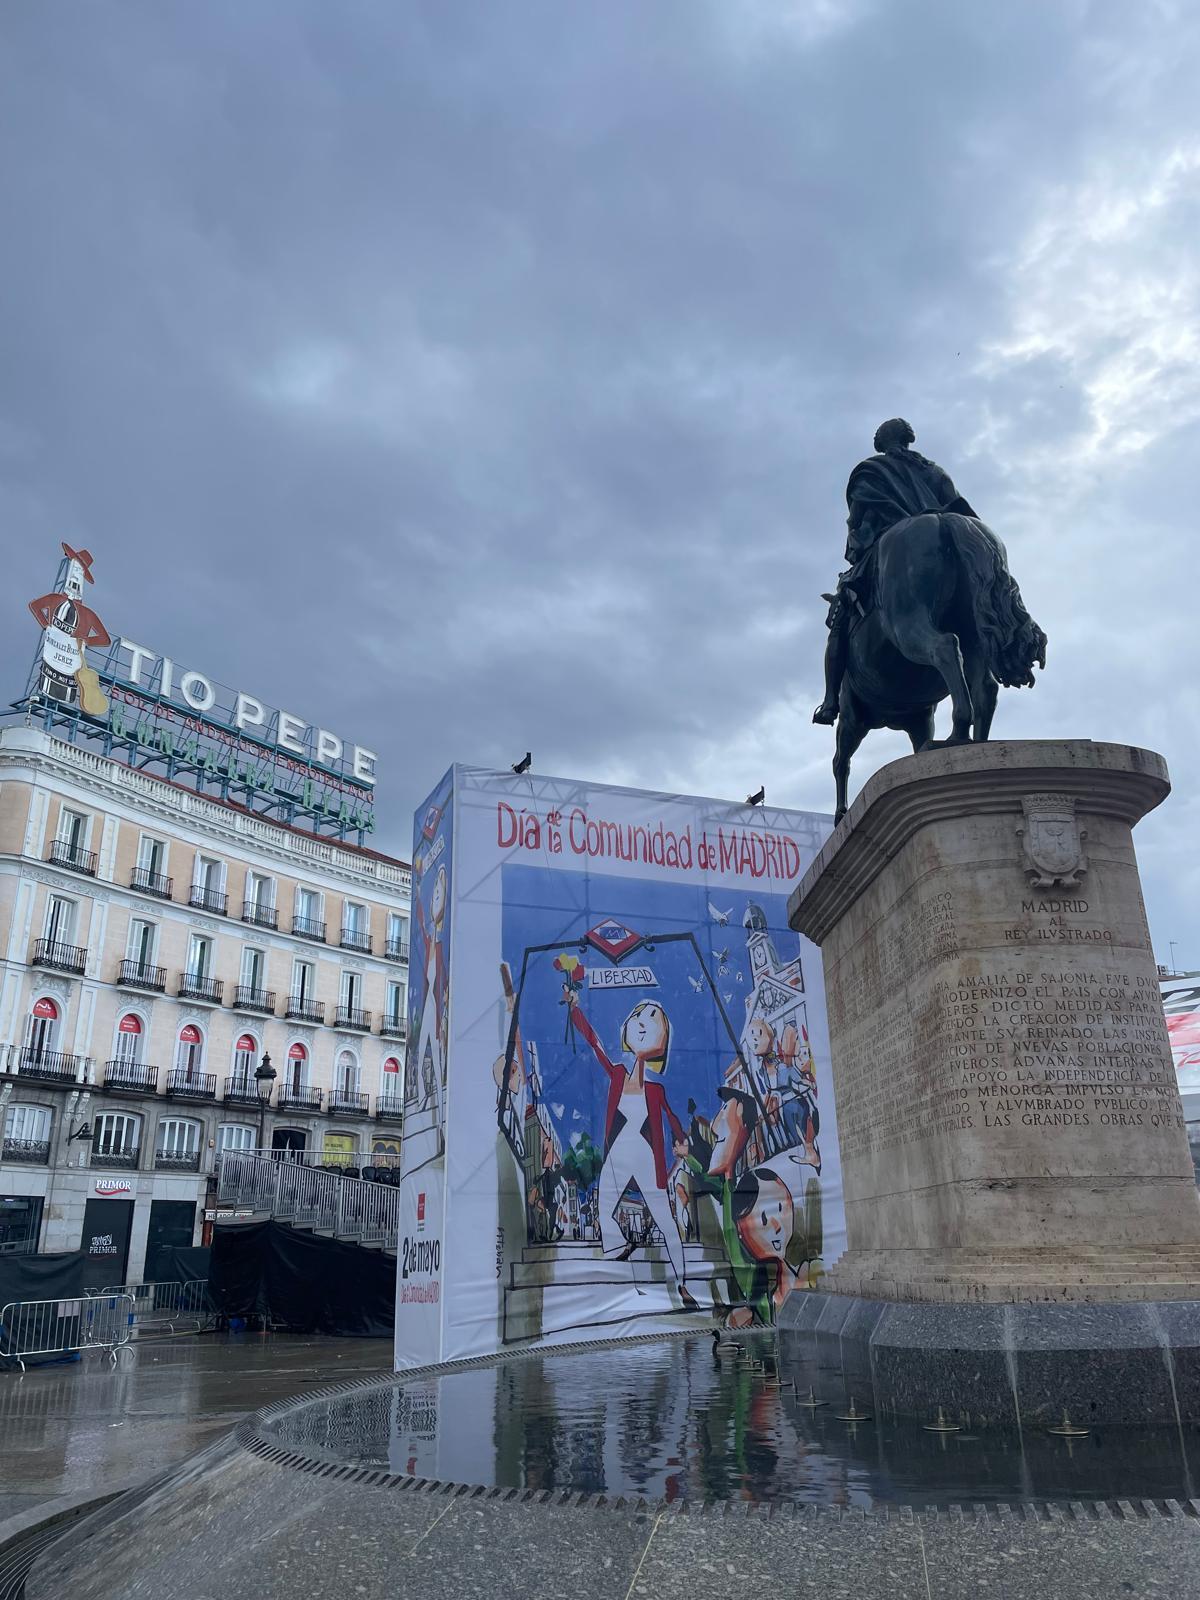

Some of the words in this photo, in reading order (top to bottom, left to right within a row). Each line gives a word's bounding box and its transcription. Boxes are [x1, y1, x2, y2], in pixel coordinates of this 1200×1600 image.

[111, 686, 147, 712] SOL
[154, 703, 176, 721] DE
[120, 637, 216, 711] TIO
[236, 691, 377, 785] PEPE
[547, 804, 562, 827] de
[498, 802, 540, 849] Día
[549, 826, 563, 853] la
[569, 808, 693, 869] Comunidad
[698, 832, 717, 871] de
[719, 827, 800, 879] MADRID
[1021, 900, 1089, 913] MADRID
[1049, 916, 1066, 926] AL
[1005, 929, 1032, 940] REY
[1038, 929, 1112, 940] ILVSTRADO
[592, 969, 652, 985] LIBERTAD
[958, 975, 1009, 988] AMALIA
[1016, 973, 1033, 984] DE
[1106, 974, 1129, 985] FVE
[943, 986, 1027, 1004] MODERNIZO
[1035, 986, 1052, 997] EL
[1062, 986, 1090, 997] PAIS
[1100, 987, 1126, 998] CON
[992, 1001, 1044, 1012] DICTO
[1055, 1001, 1121, 1012] MEDIDAS
[1129, 1002, 1156, 1016] PARA
[983, 1015, 1000, 1026] LA
[1009, 1014, 1077, 1025] CREACION
[1086, 1014, 1103, 1025] DE
[997, 1028, 1016, 1039] SV
[1027, 1028, 1093, 1039] REINADO
[1103, 1028, 1128, 1039] LAS
[986, 1042, 1005, 1053] DE
[1013, 1041, 1068, 1054] NVEVAS
[1078, 1041, 1162, 1055] POBLACIONES
[1013, 1056, 1084, 1067] ADVANAS
[1094, 1056, 1154, 1068] INTERNAS
[1160, 1058, 1167, 1070] Y
[962, 1071, 1008, 1085] APOYO
[1017, 1070, 1035, 1081] LA
[1044, 1070, 1143, 1081] INDEPENDENCIA
[1149, 1071, 1163, 1083] DE
[1065, 1084, 1124, 1096] IMPVLSO
[1132, 1086, 1149, 1096] LA
[980, 1100, 988, 1111] Y
[996, 1099, 1085, 1111] ALVMBRADO
[1159, 1100, 1170, 1112] LA
[984, 1114, 1012, 1127] LAS
[1022, 1114, 1090, 1126] GRANDES
[1101, 1114, 1143, 1126] OBRAS
[1151, 1115, 1173, 1129] QVE
[95, 1179, 131, 1190] PRIMOR
[89, 1246, 118, 1254] PRIMOR
[402, 1237, 409, 1279] 2
[409, 1236, 416, 1273] de
[417, 1240, 440, 1276] mayo
